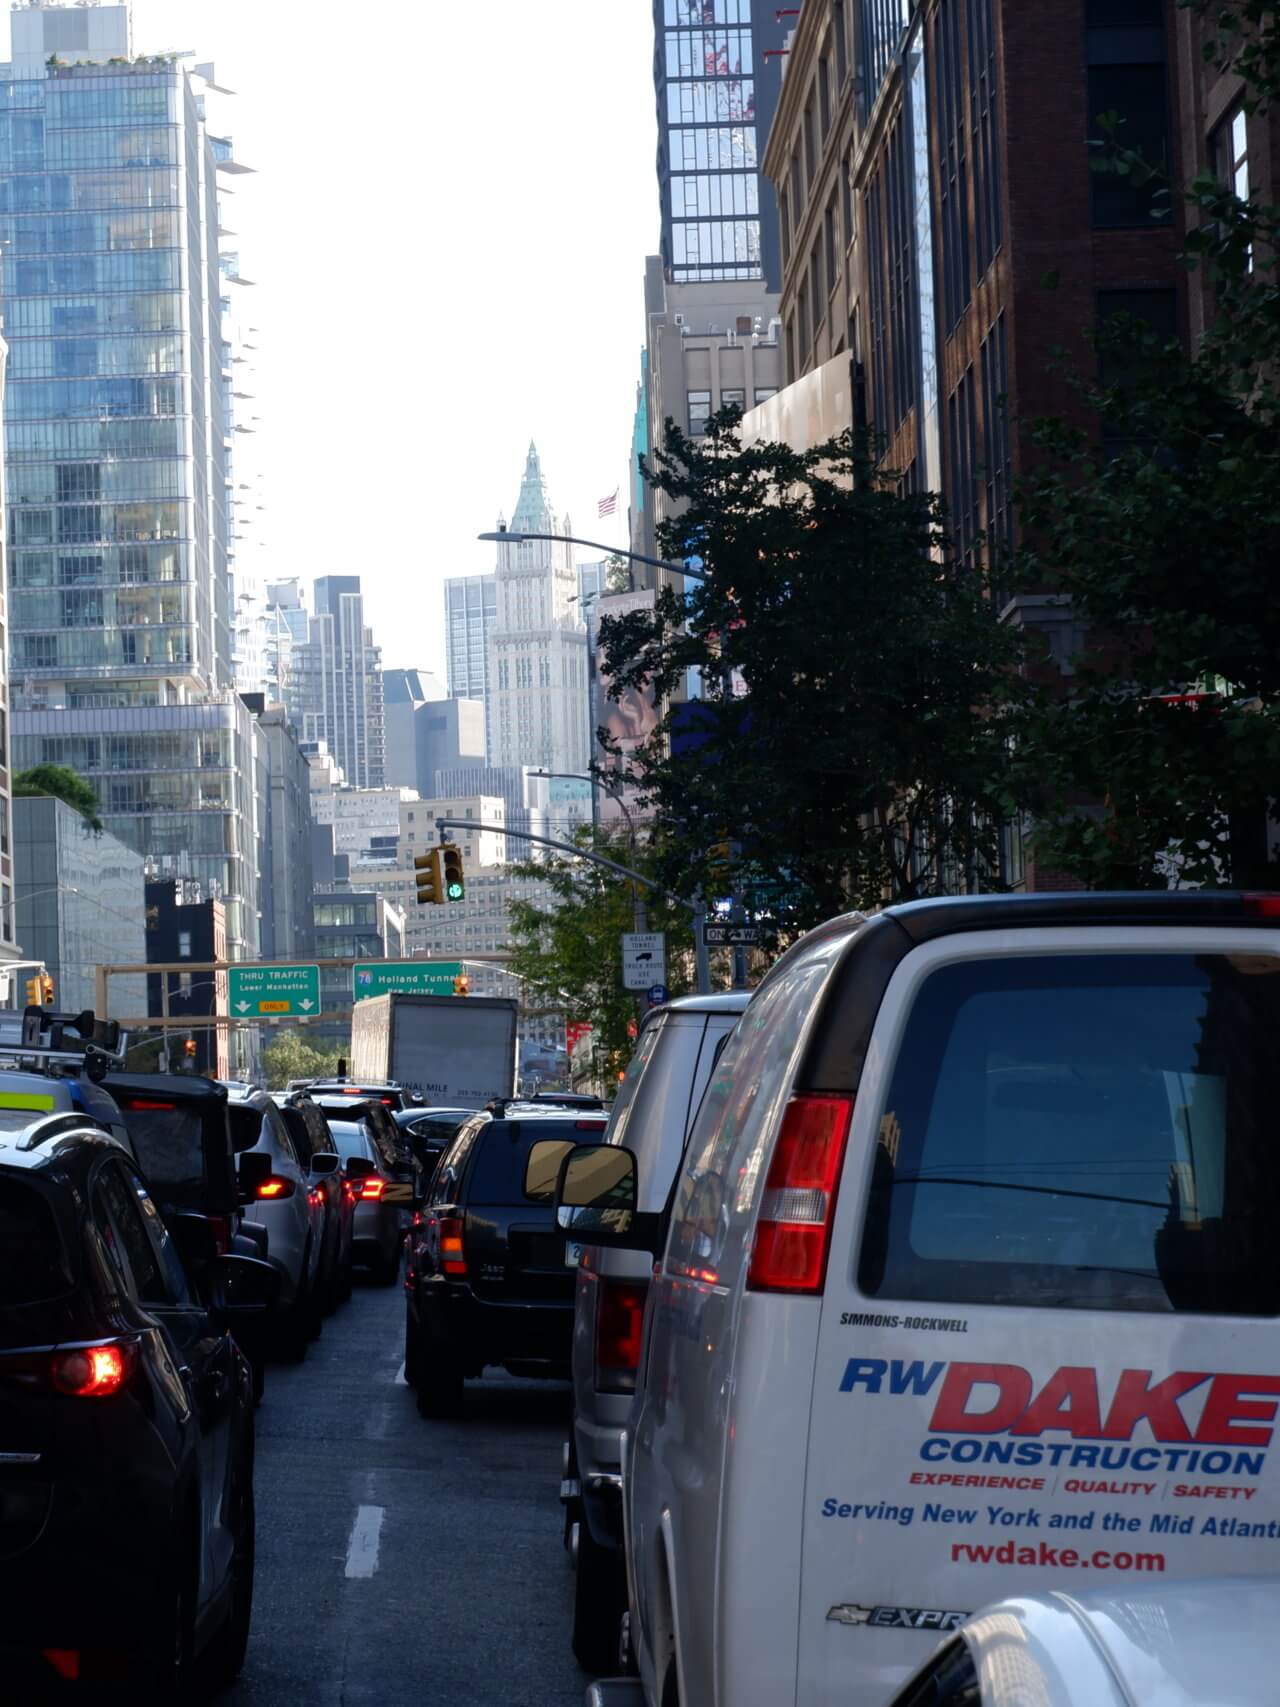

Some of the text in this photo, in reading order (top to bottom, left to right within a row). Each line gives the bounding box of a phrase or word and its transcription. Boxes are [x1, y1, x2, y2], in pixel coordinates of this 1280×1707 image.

[239, 970, 308, 981] THRU TRAFFIC
[378, 974, 458, 984] Holland Tunne
[239, 982, 309, 992] Lower Manhattan
[263, 1001, 285, 1011] ONLY
[426, 1083, 449, 1093] MILE
[840, 1312, 969, 1333] SIMMONS-ROCKWELL
[919, 1437, 1265, 1476] CONSTRUCTION
[909, 1471, 1257, 1500] EXPERIENCE QUALITY SAFETY
[821, 1498, 914, 1526] Serving
[921, 1503, 977, 1524] New
[985, 1505, 1040, 1528] York
[1047, 1511, 1095, 1530] and
[1102, 1512, 1142, 1532] the
[1149, 1514, 1195, 1535] Mid
[950, 1539, 1166, 1572] rwdake.com
